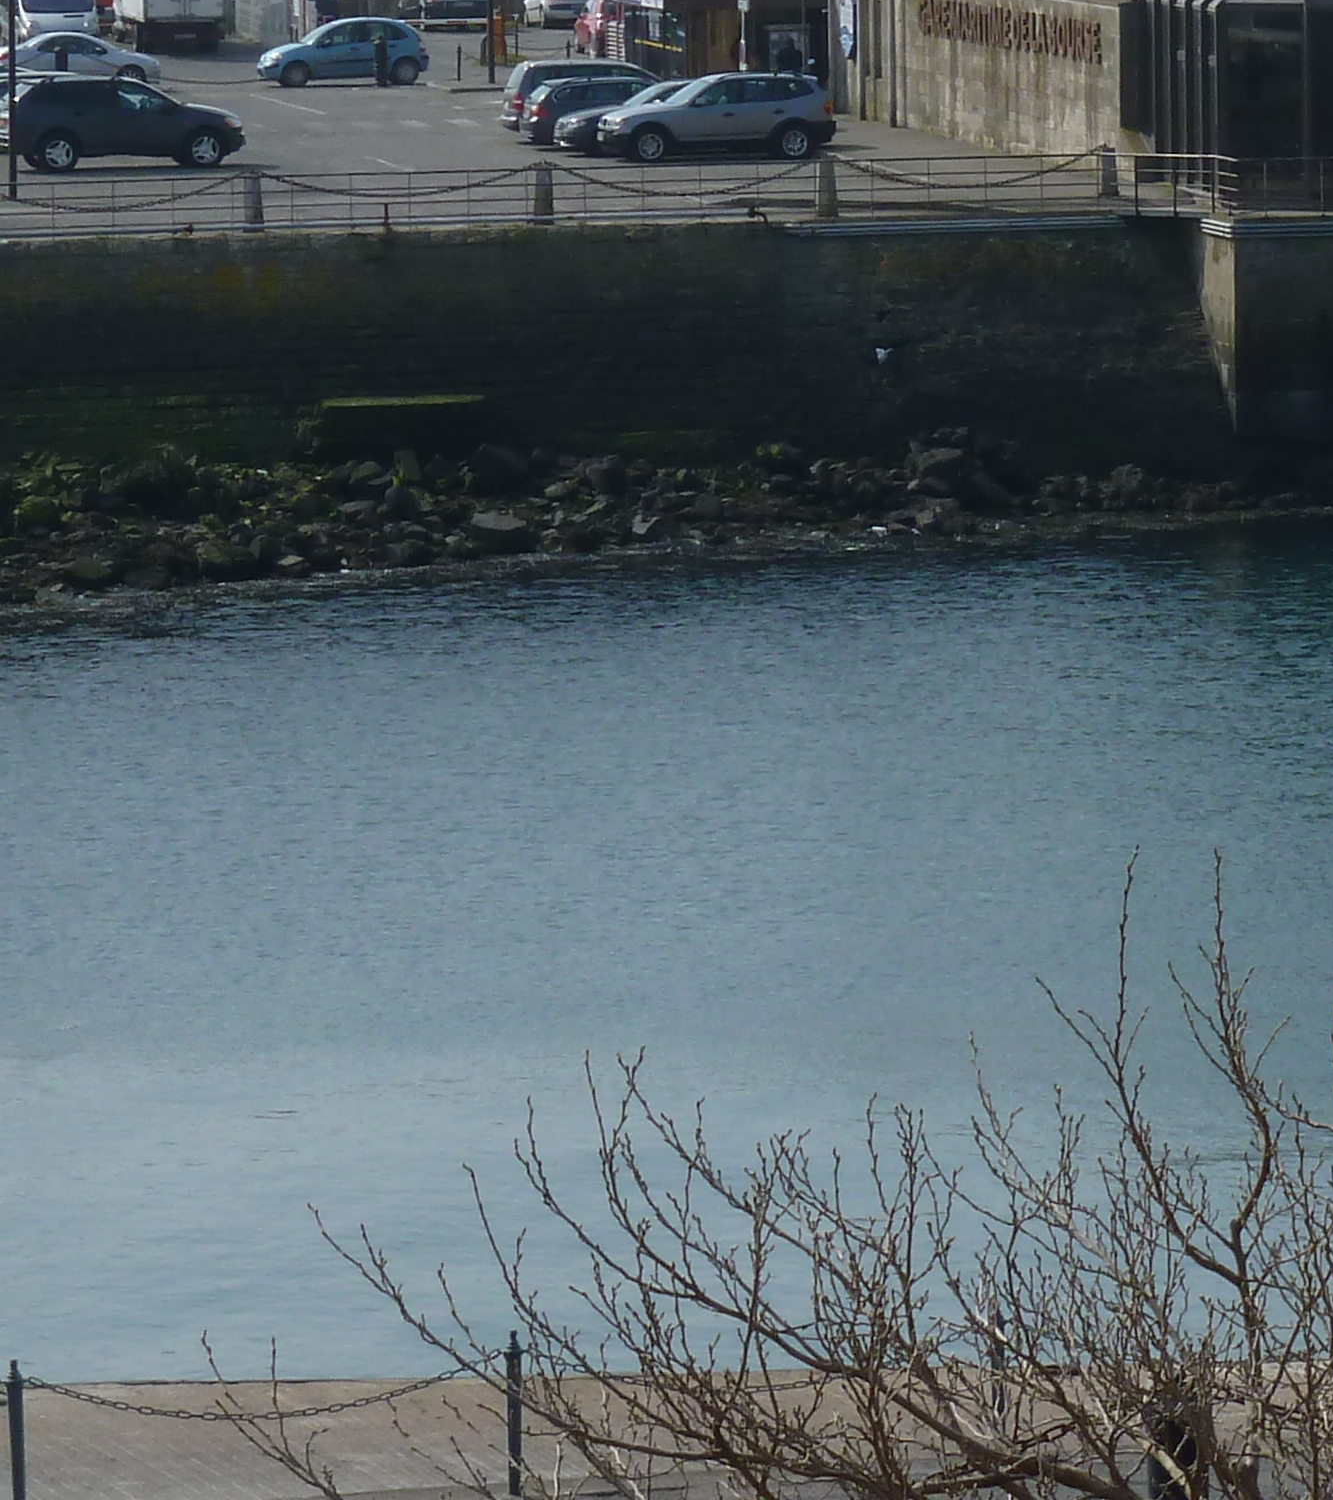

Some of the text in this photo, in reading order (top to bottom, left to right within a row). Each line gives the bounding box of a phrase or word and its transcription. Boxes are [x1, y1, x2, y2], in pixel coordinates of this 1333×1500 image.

[950, 0, 1012, 50] MARITIME
[1013, 9, 1031, 53] DE
[1031, 11, 1049, 55] LA
[1050, 14, 1102, 65] BOURSE
